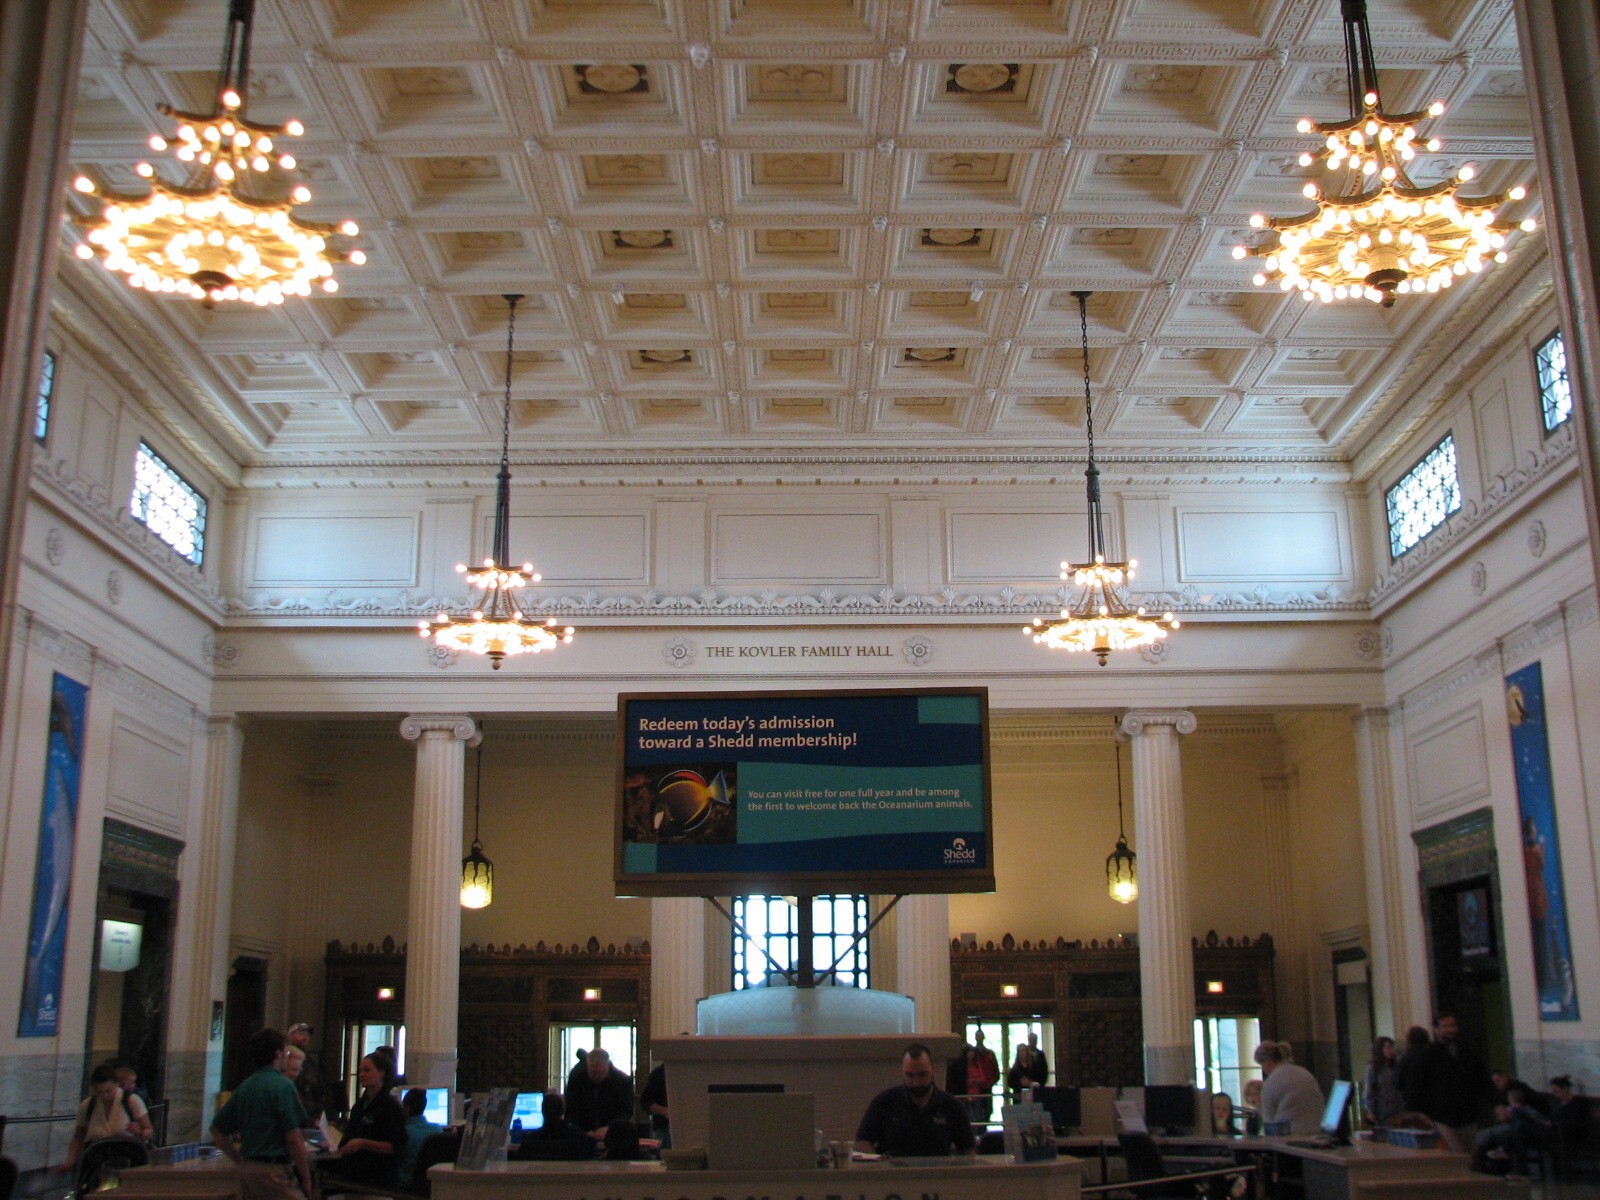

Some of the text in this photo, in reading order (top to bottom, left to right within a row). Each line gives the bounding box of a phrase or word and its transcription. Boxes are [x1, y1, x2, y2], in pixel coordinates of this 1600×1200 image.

[705, 645, 894, 657] THE KOVLER FAMILY HALL
[639, 718, 698, 731] Redeem
[759, 715, 835, 729] admission
[639, 732, 857, 750] toward a Shedd membership!
[748, 790, 765, 799] You
[784, 789, 802, 798] visit
[804, 789, 822, 797] free
[824, 788, 837, 797] for
[858, 788, 873, 797] full
[875, 790, 894, 799] year
[896, 788, 913, 796] and
[915, 788, 926, 796] be
[928, 789, 960, 797] among
[748, 799, 973, 811] the first to welcome back the Oceanarium animals.
[944, 848, 975, 859] Shedd
